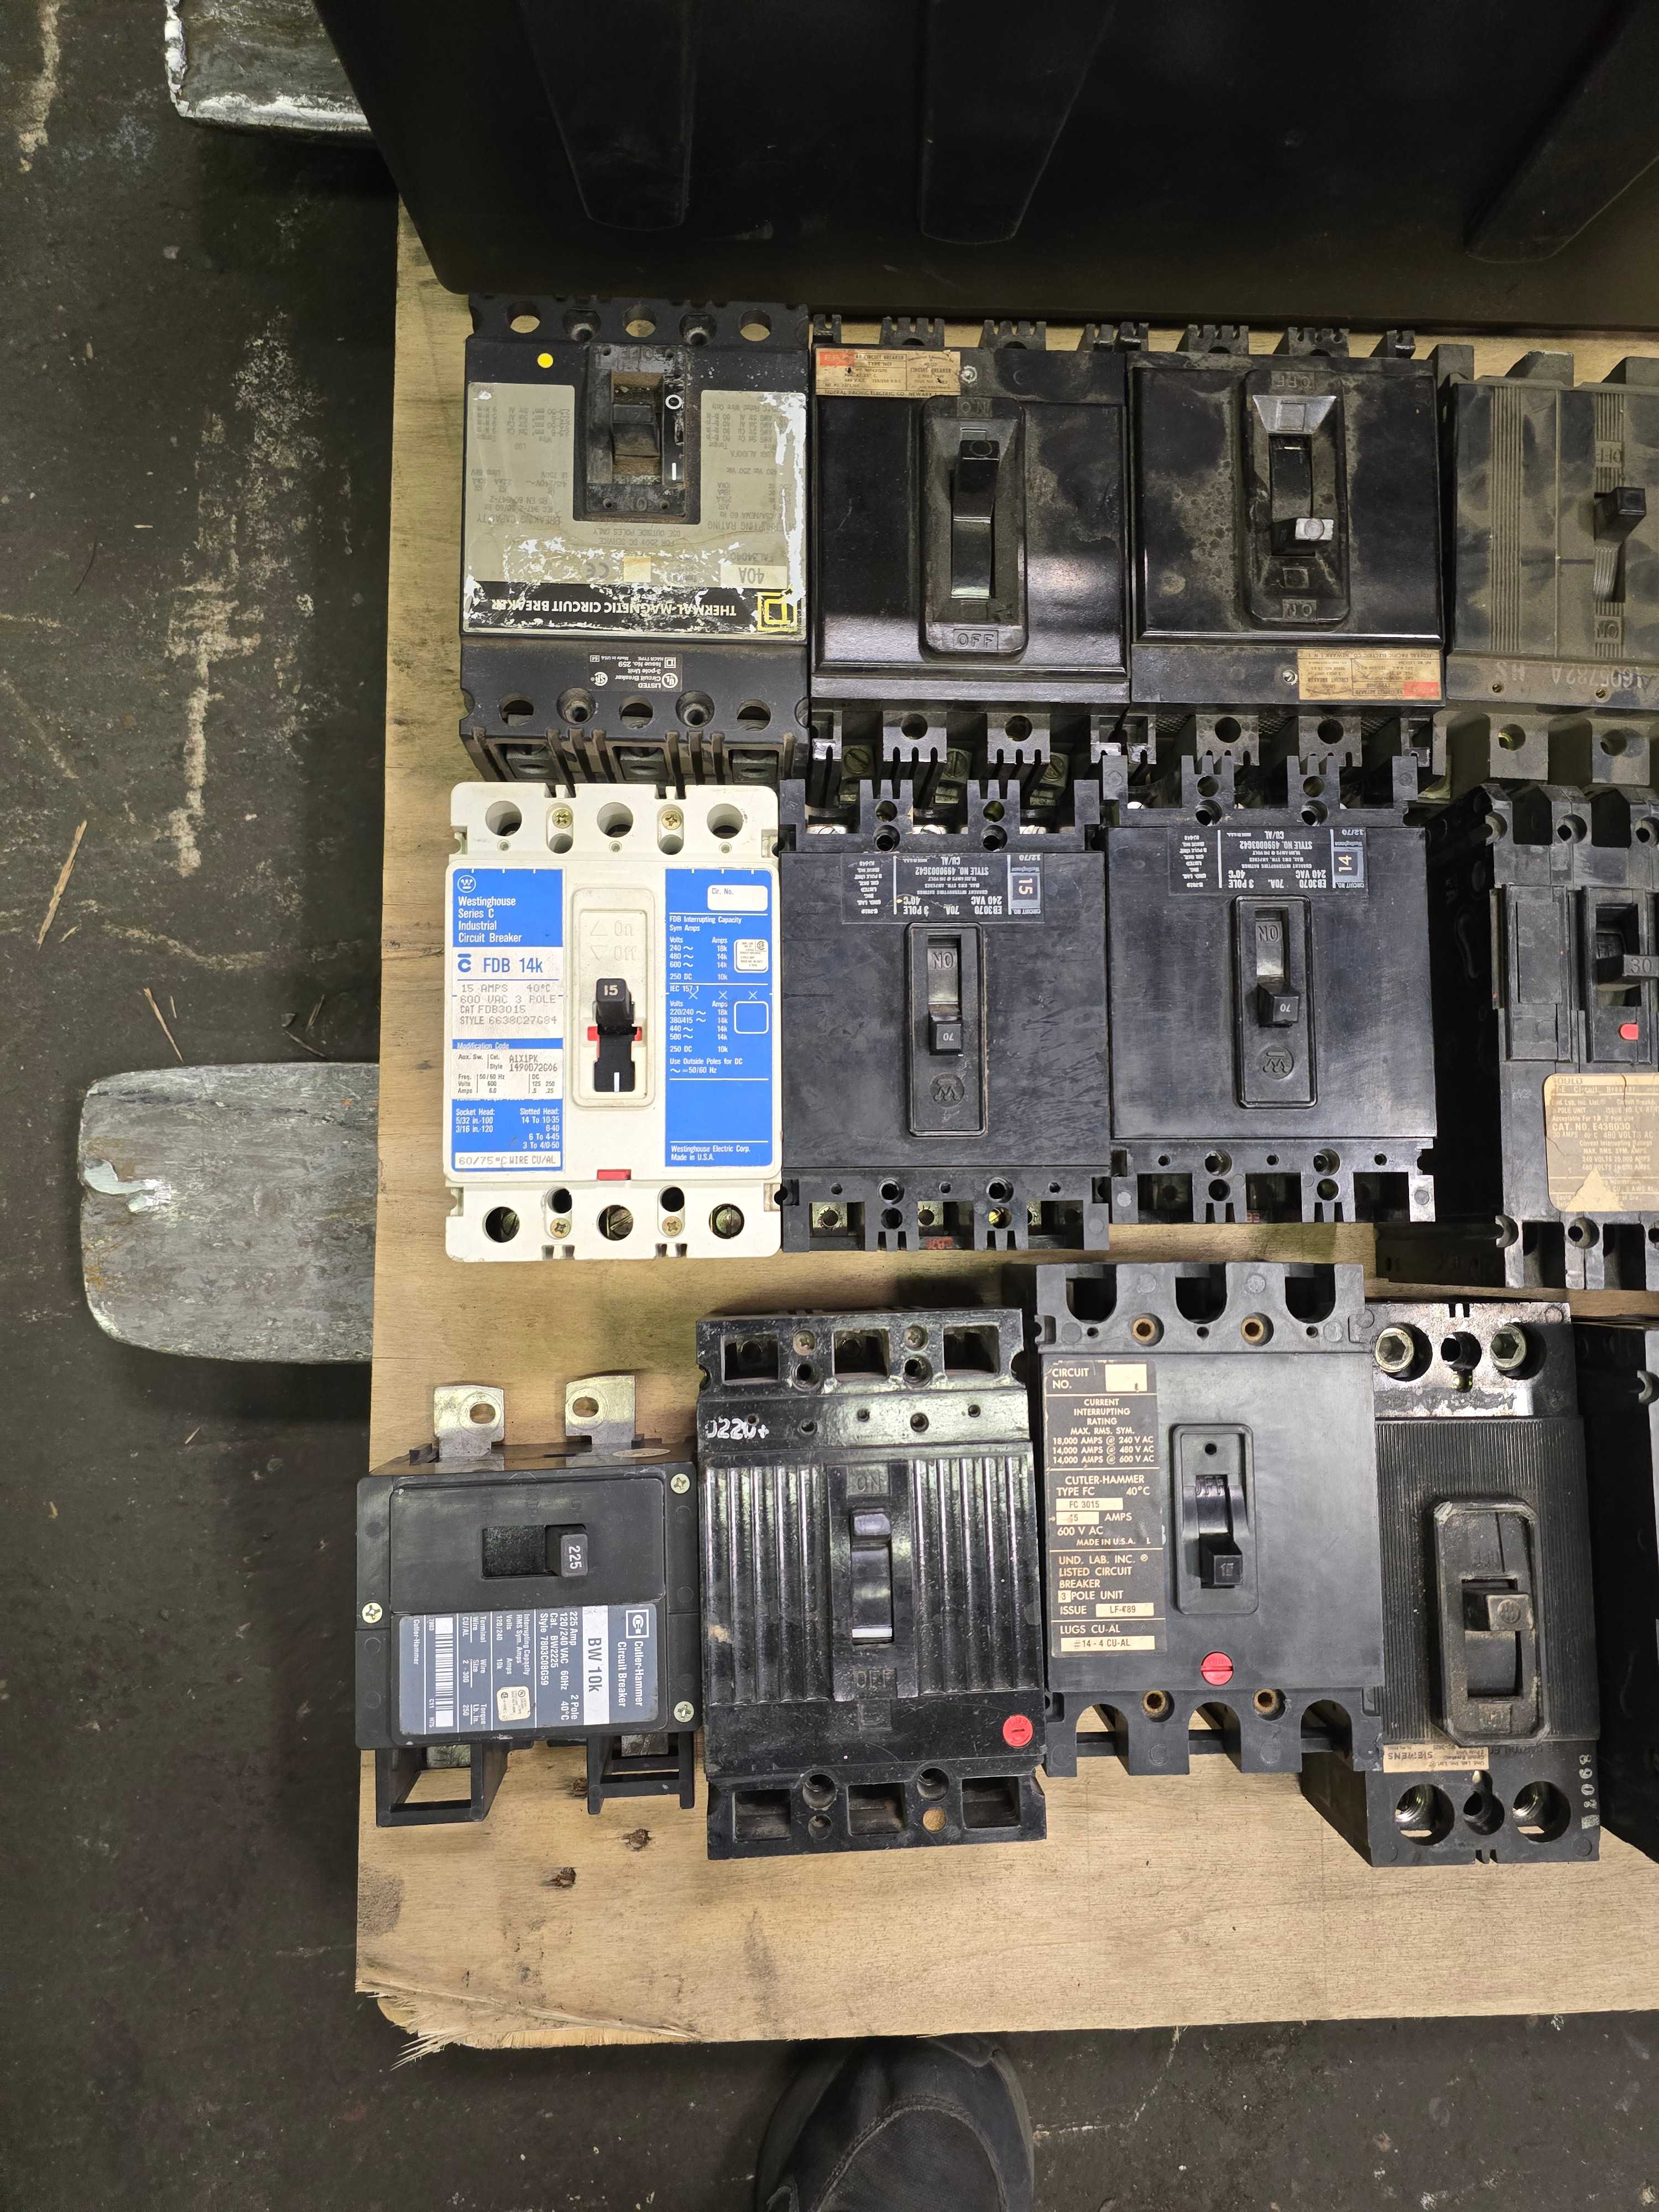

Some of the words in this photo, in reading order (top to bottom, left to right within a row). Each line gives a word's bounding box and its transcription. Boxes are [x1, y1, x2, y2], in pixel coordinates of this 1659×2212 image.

[1277, 374, 1314, 387] OFF
[961, 400, 989, 414] ON
[708, 521, 736, 530] RATING
[738, 566, 766, 584] 40A
[489, 598, 550, 612] BREAKER
[552, 599, 601, 614] CIRCUIT
[603, 601, 737, 617] THERMAL-MAGNETIC
[957, 633, 995, 648] OFF
[1294, 840, 1313, 849] STYLE
[1338, 855, 1353, 872] 14
[970, 867, 989, 875] STYLE
[1228, 869, 1245, 878] 40°C
[1295, 869, 1311, 878] VAC
[1312, 869, 1327, 878] 240
[1018, 878, 1034, 895] 15
[1228, 879, 1247, 888] POLE
[1298, 879, 1327, 888] EB3070
[458, 896, 517, 907] Westinghouse
[902, 896, 921, 905] 40°C
[970, 895, 985, 905] VAC
[987, 895, 1002, 905] 240
[458, 908, 484, 919] Series
[488, 908, 495, 919] C
[902, 905, 922, 915] POLE
[974, 905, 1002, 915] EB3070
[458, 920, 498, 931] Industrial
[684, 916, 716, 924] Interrupting
[718, 916, 743, 925] Capacity
[614, 920, 634, 937] On
[1258, 925, 1279, 942] ON
[458, 932, 486, 943] Circuit
[489, 932, 523, 943] Breaker
[614, 945, 638, 961] Off
[483, 957, 511, 973] FDB
[519, 957, 544, 973] 14k
[932, 952, 953, 969] ON
[1630, 957, 1652, 973] 30
[461, 984, 474, 993] 15
[480, 984, 508, 993] AMPS
[526, 984, 552, 993] 40°C
[603, 984, 620, 997] 15
[460, 1005, 475, 1014] CAT
[477, 1005, 526, 1014] FDB3015
[1279, 1003, 1291, 1012] 70
[942, 1032, 954, 1041] 70
[1552, 1123, 1572, 1131] CAT.
[1575, 1123, 1590, 1131] NO.
[670, 1145, 711, 1154] Westinghouse
[735, 1145, 752, 1153] Corp.
[509, 1156, 529, 1165] WIRE
[531, 1155, 556, 1164] CU/AL
[1051, 1368, 1090, 1378] CIRCUIT
[1052, 1379, 1072, 1390] NO.
[1083, 1398, 1120, 1406] CURRENT
[1073, 1407, 1131, 1416] INTERRUPTING
[1087, 1417, 1118, 1426] RATING
[1070, 1427, 1092, 1436] MAX.
[1093, 1427, 1113, 1435] RMS.
[1115, 1426, 1135, 1435] SYM.
[1052, 1437, 1078, 1446] 18,000
[1080, 1437, 1104, 1445] AMPS
[856, 1474, 880, 1492] ON
[1064, 1474, 1145, 1486] CUTLER-HAMMER
[1056, 1487, 1080, 1497] TYPE
[1082, 1486, 1095, 1496] FC
[1125, 1485, 1151, 1496] 40°C
[1069, 1500, 1079, 1509] FC
[1081, 1500, 1100, 1509] 3015
[1104, 1512, 1133, 1522] AMPS
[1056, 1526, 1076, 1537] 600
[1088, 1526, 1104, 1536] AC
[1076, 1538, 1100, 1547] MADE
[1100, 1538, 1112, 1546] IN
[568, 1545, 582, 1570] 225
[1058, 1555, 1084, 1566] UND.
[1089, 1554, 1110, 1565] LAB.
[1114, 1554, 1136, 1564] INC.
[1058, 1567, 1091, 1577] LISTED
[1094, 1566, 1134, 1576] CIRCUIT
[1058, 1579, 1102, 1589] BREAKER
[1062, 1592, 1067, 1600] 3
[1071, 1590, 1096, 1600] POLE
[1100, 1590, 1125, 1600] UNIT
[1060, 1605, 1088, 1615] ISSUE
[538, 1613, 549, 1633] Style
[570, 1611, 578, 1626] 225
[559, 1611, 569, 1646] 120/240
[1060, 1625, 1087, 1635] LUGS
[1091, 1624, 1121, 1634] CU-AL
[412, 1618, 420, 1666] Cutler-Hammer
[568, 1627, 578, 1646] Amp
[550, 1635, 559, 1668] BW2225
[588, 1637, 602, 1661] BW
[540, 1635, 549, 1686] 7803C08G59
[560, 1647, 569, 1664] VAC
[617, 1641, 628, 1671] Circuit
[634, 1640, 645, 1707] Cutler-Hammer
[856, 1668, 895, 1688] OFF
[560, 1670, 569, 1691] 60Hz
[588, 1666, 603, 1693] 10k
[618, 1672, 628, 1708] Breaker
[560, 1700, 570, 1720] 40°C
[570, 1702, 580, 1720] Pole
[1387, 1751, 1433, 1760] SIEMENS
